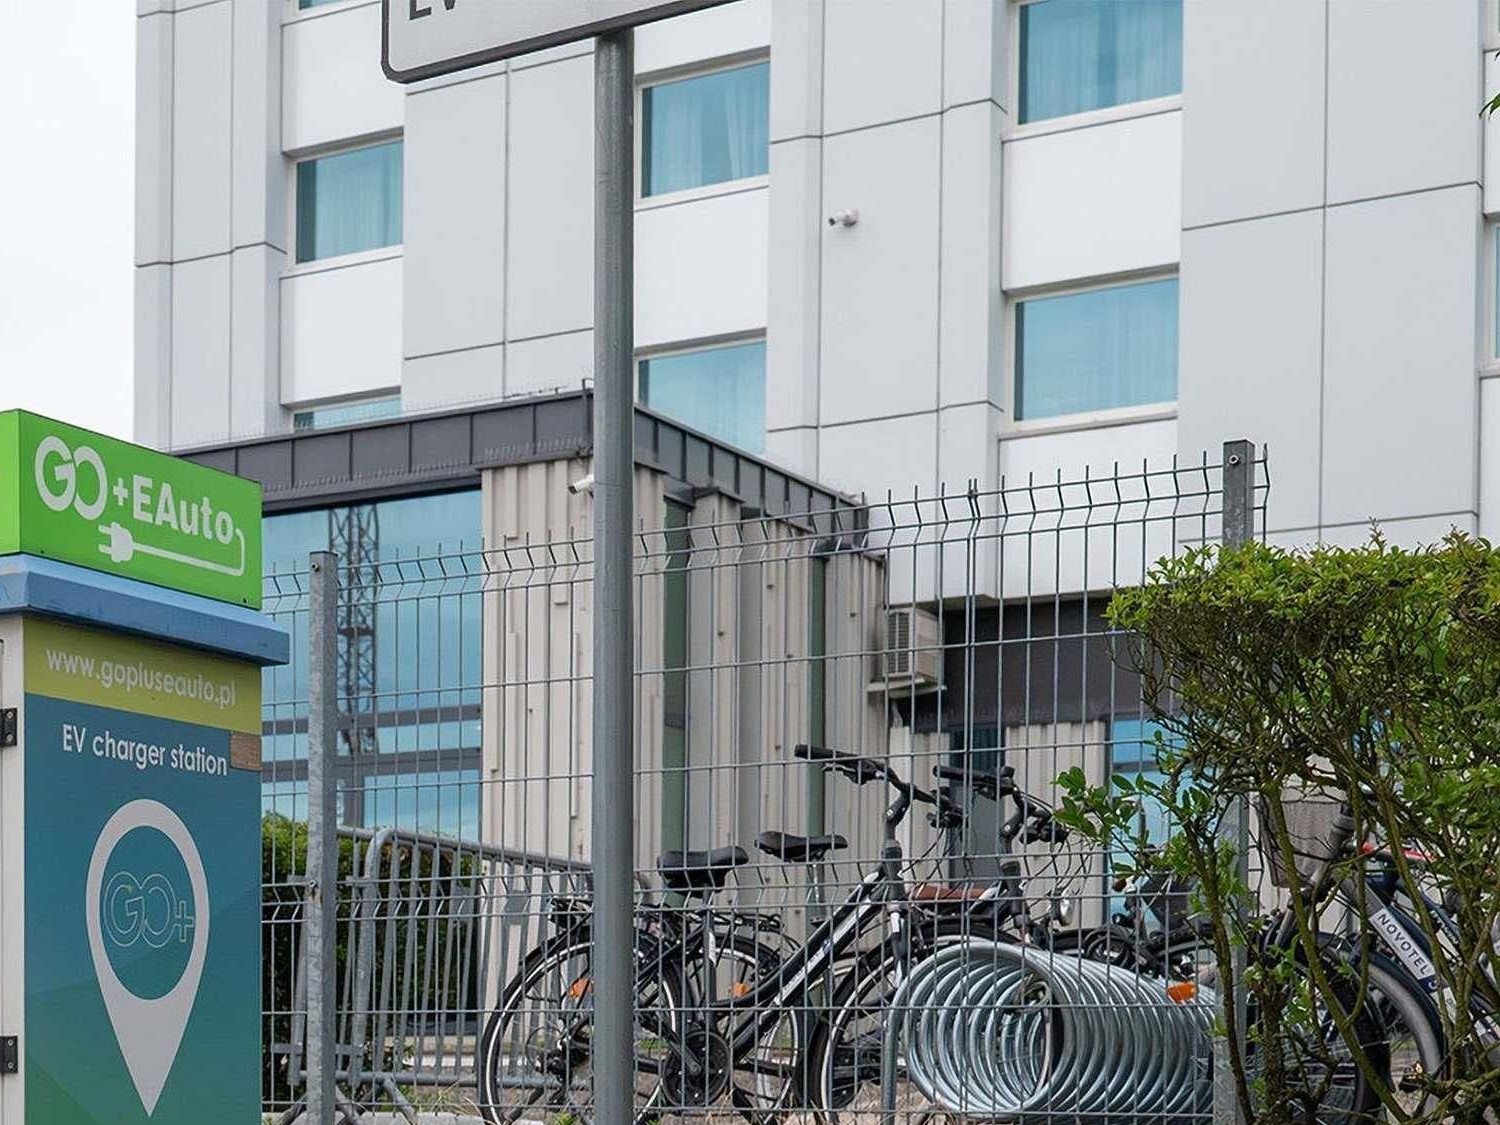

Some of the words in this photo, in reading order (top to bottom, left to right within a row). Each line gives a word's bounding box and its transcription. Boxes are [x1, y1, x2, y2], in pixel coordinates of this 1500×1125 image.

[46, 649, 236, 708] www.gopluseauto.pl
[62, 723, 86, 753] EV
[92, 730, 166, 770] charger
[170, 743, 228, 776] station
[1377, 913, 1430, 975] NOVOTEL
